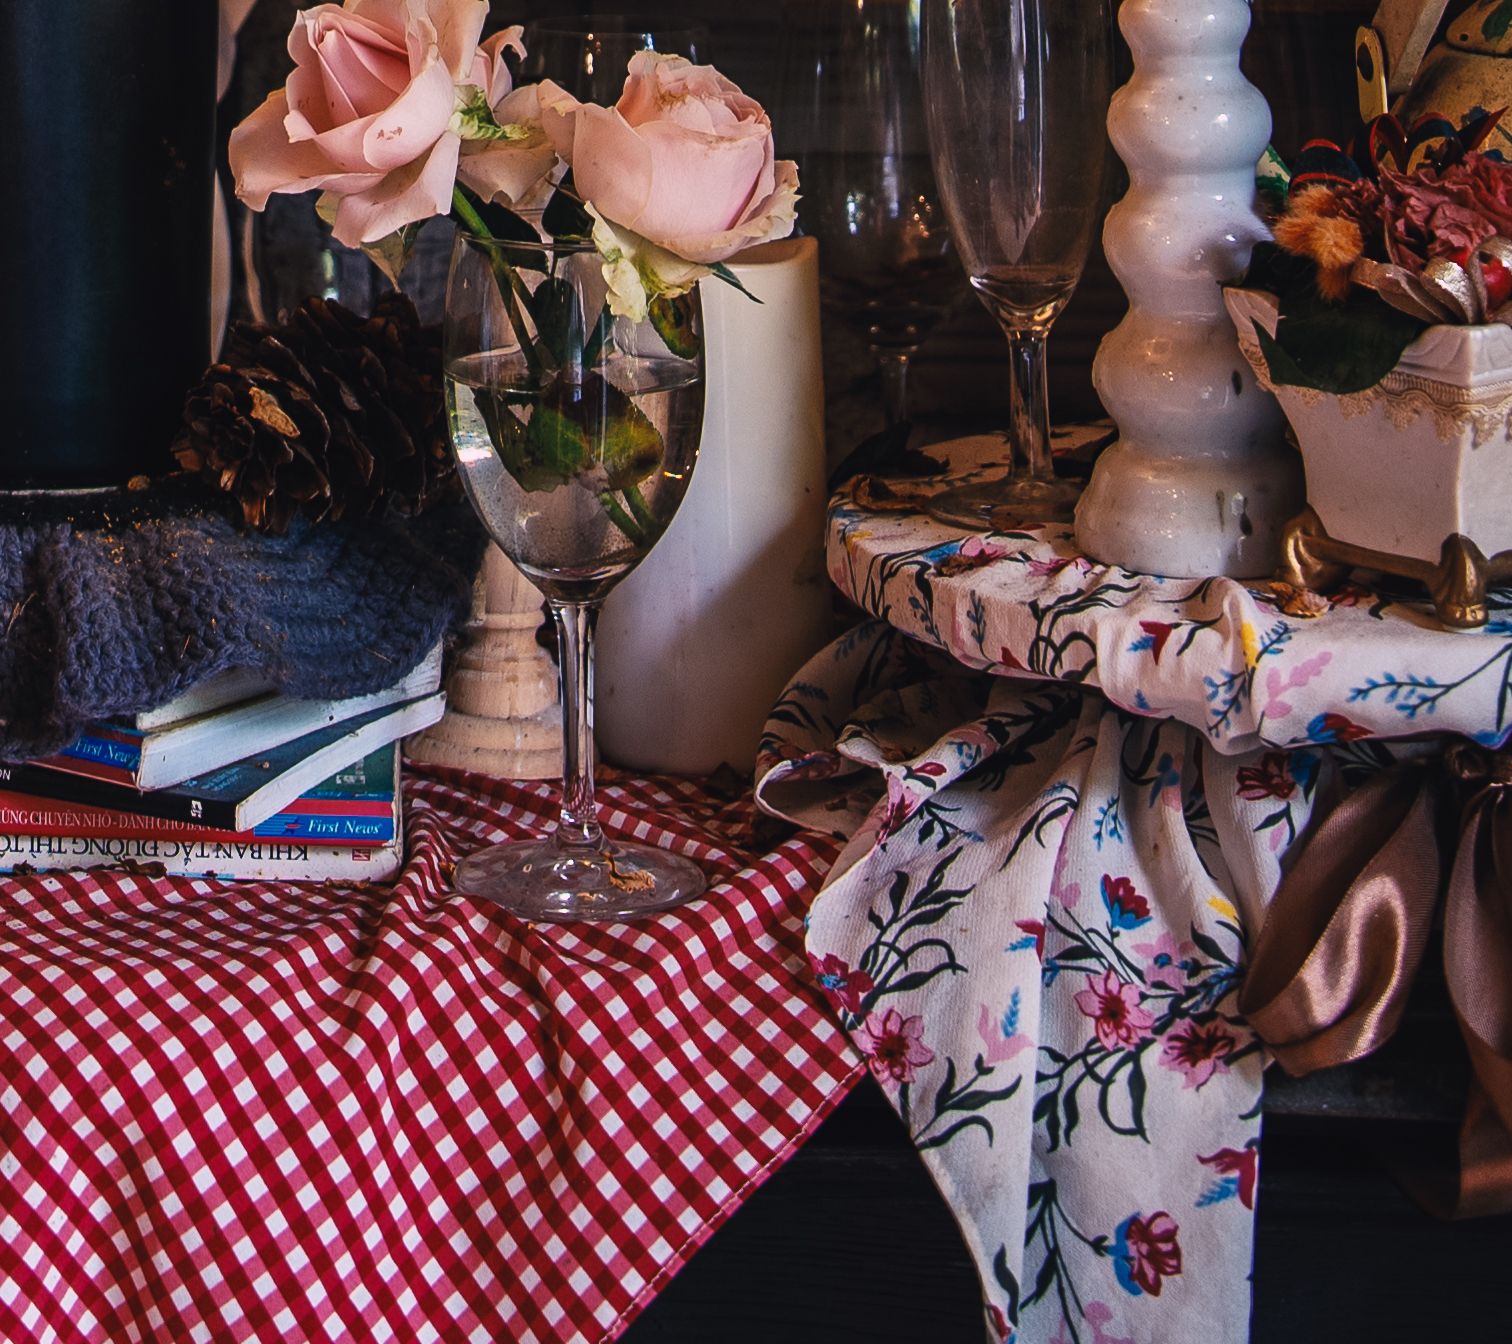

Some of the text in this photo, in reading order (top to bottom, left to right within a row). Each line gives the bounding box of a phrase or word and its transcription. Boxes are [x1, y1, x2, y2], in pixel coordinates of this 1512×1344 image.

[308, 819, 381, 835] First News
[268, 844, 309, 861] KHI
